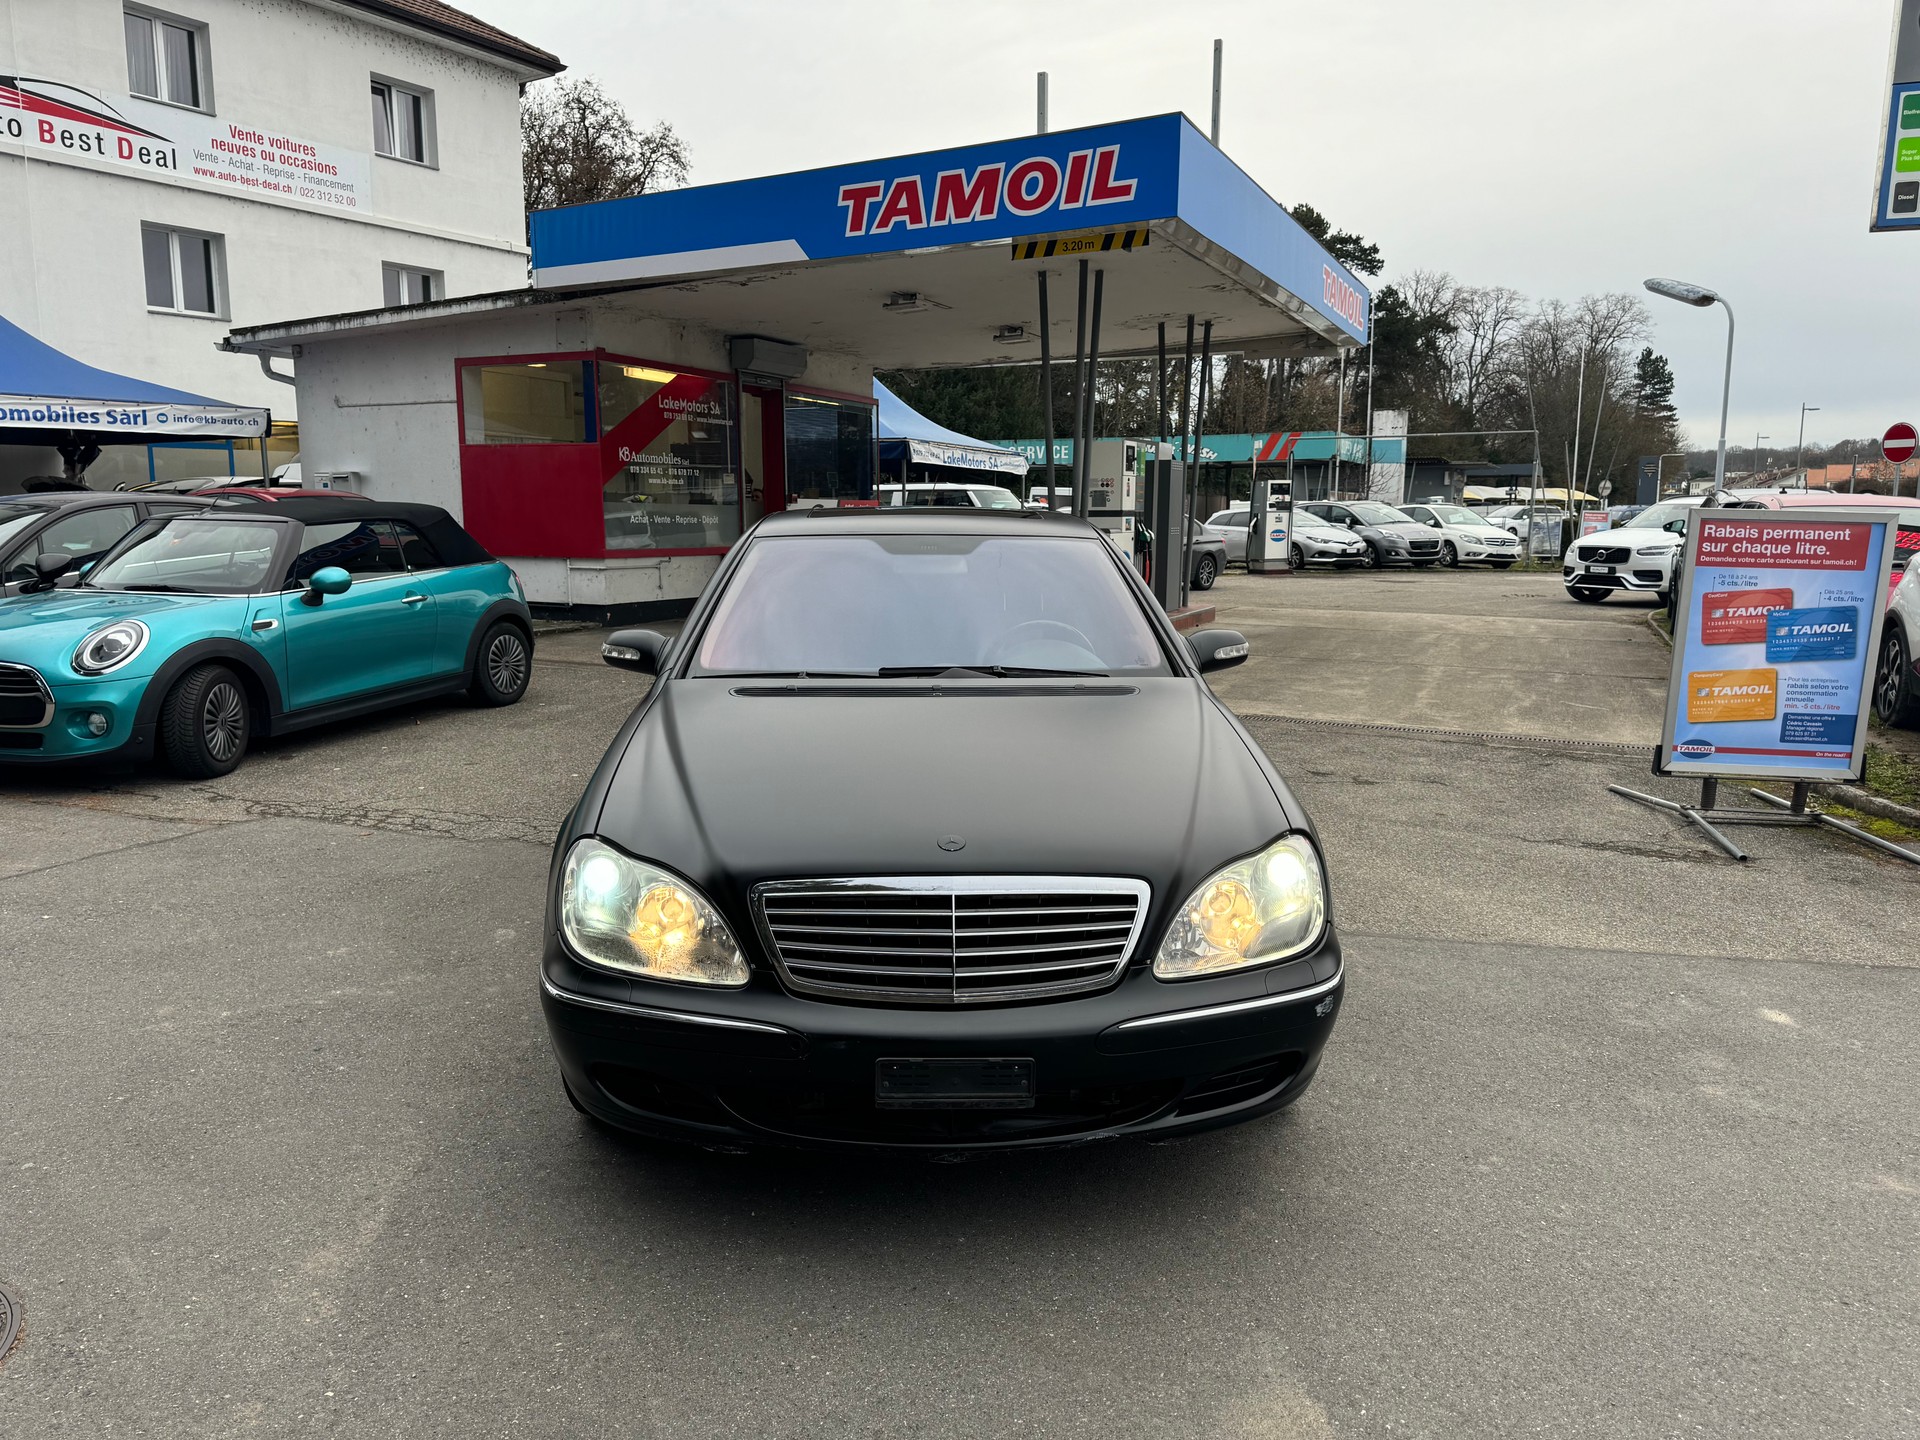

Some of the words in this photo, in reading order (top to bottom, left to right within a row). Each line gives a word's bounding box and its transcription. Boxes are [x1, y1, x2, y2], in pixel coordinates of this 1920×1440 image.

[38, 119, 105, 155] Best
[117, 136, 177, 170] Deal
[229, 124, 264, 145] Vente
[268, 137, 316, 157] voitures
[211, 138, 256, 158] neuves
[261, 150, 275, 162] ou
[279, 153, 338, 176] occasions
[193, 149, 219, 164] Vente
[228, 157, 254, 172] Achat
[263, 164, 295, 181] Reprise
[303, 173, 354, 193] Financement
[193, 166, 293, 194] www.auto-best-deal.ch
[300, 187, 315, 199] 022
[317, 190, 332, 203] 312
[334, 193, 344, 205] 52
[346, 196, 356, 207] 00
[837, 143, 1138, 237] TAMOIL
[1062, 240, 1082, 252] 3.20
[1084, 240, 1095, 250] m
[1322, 263, 1364, 332] TAMOIL
[658, 394, 708, 413] LakeMotors
[710, 401, 720, 415] SA
[172, 414, 259, 427] info@kb-auto.ch
[618, 446, 630, 462] KB
[630, 451, 682, 465] Automobiles
[942, 450, 986, 469] LakeMotors
[988, 454, 998, 470] SA
[630, 515, 648, 524] Achat
[653, 515, 671, 524] Vente
[675, 515, 698, 525] Reprise
[1704, 524, 1759, 539] Rabais
[1763, 527, 1851, 542] permanent
[1702, 542, 1728, 552] sur
[1732, 541, 1791, 556] chaque
[1796, 542, 1830, 555] litre.
[1791, 623, 1853, 635] TAMOIL
[1712, 685, 1772, 696] TAMOIL
